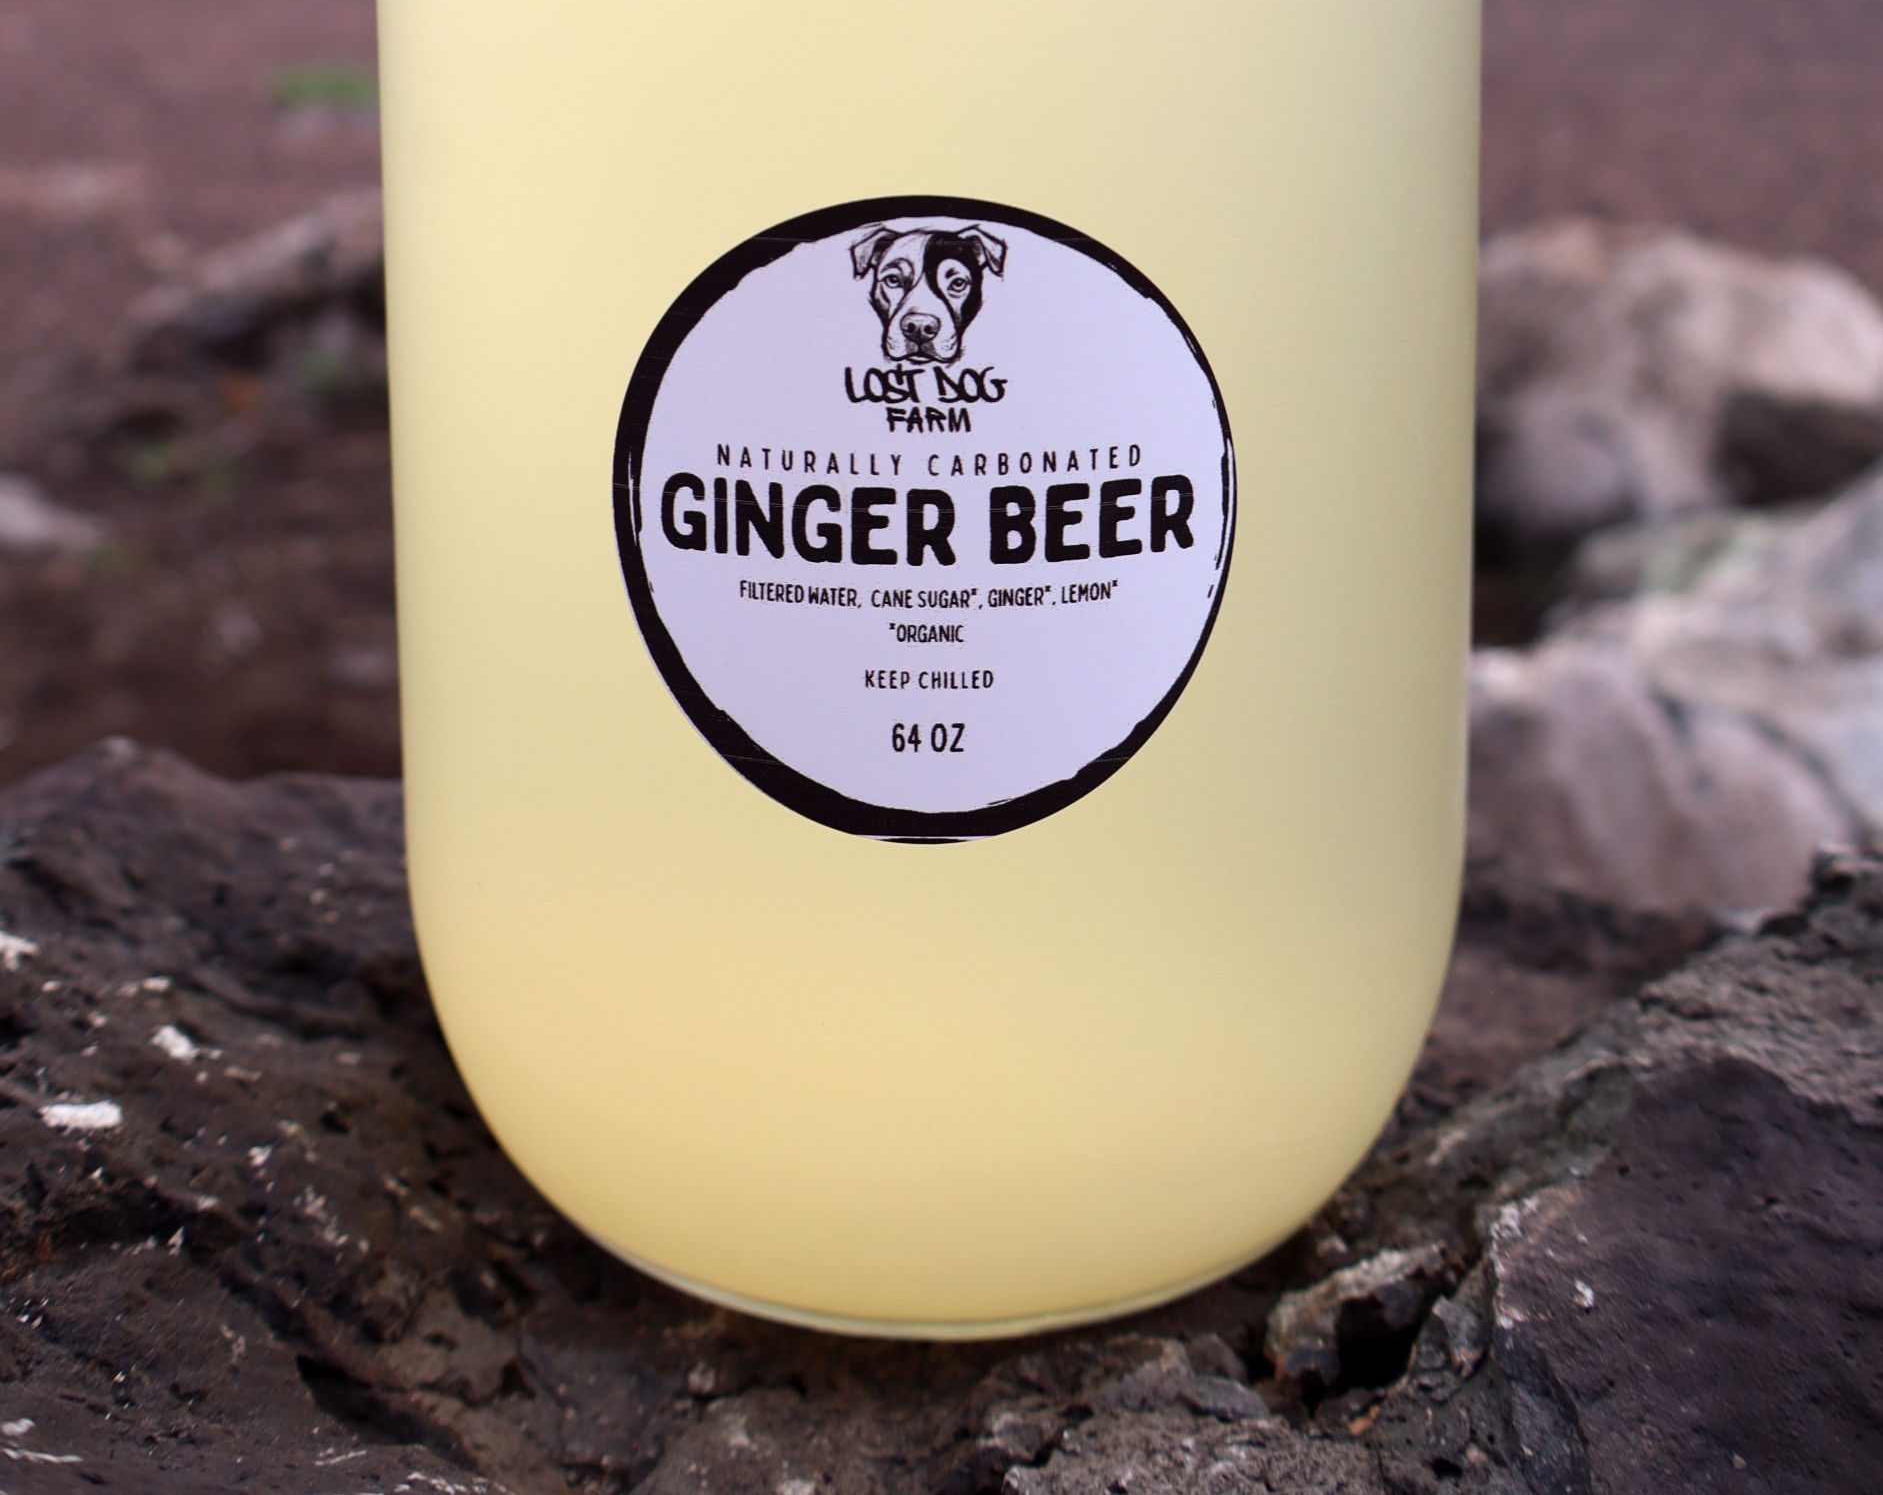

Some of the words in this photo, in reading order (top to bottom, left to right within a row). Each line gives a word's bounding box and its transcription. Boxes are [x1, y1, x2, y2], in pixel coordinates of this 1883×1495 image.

[844, 363, 926, 405] LOST
[932, 365, 1009, 404] DOG
[885, 406, 972, 434] FARM
[716, 442, 904, 477] NATURALLY
[927, 444, 1142, 478] CARBONATED
[660, 471, 957, 567] GINGER
[988, 474, 1195, 566] BEER
[739, 579, 805, 605] FILTERED
[808, 585, 863, 609] WATER,
[870, 589, 914, 609] CANE
[864, 669, 911, 690] KEEP
[918, 669, 994, 690] CHILLED
[891, 722, 922, 753] 64
[930, 722, 966, 753] OZ
